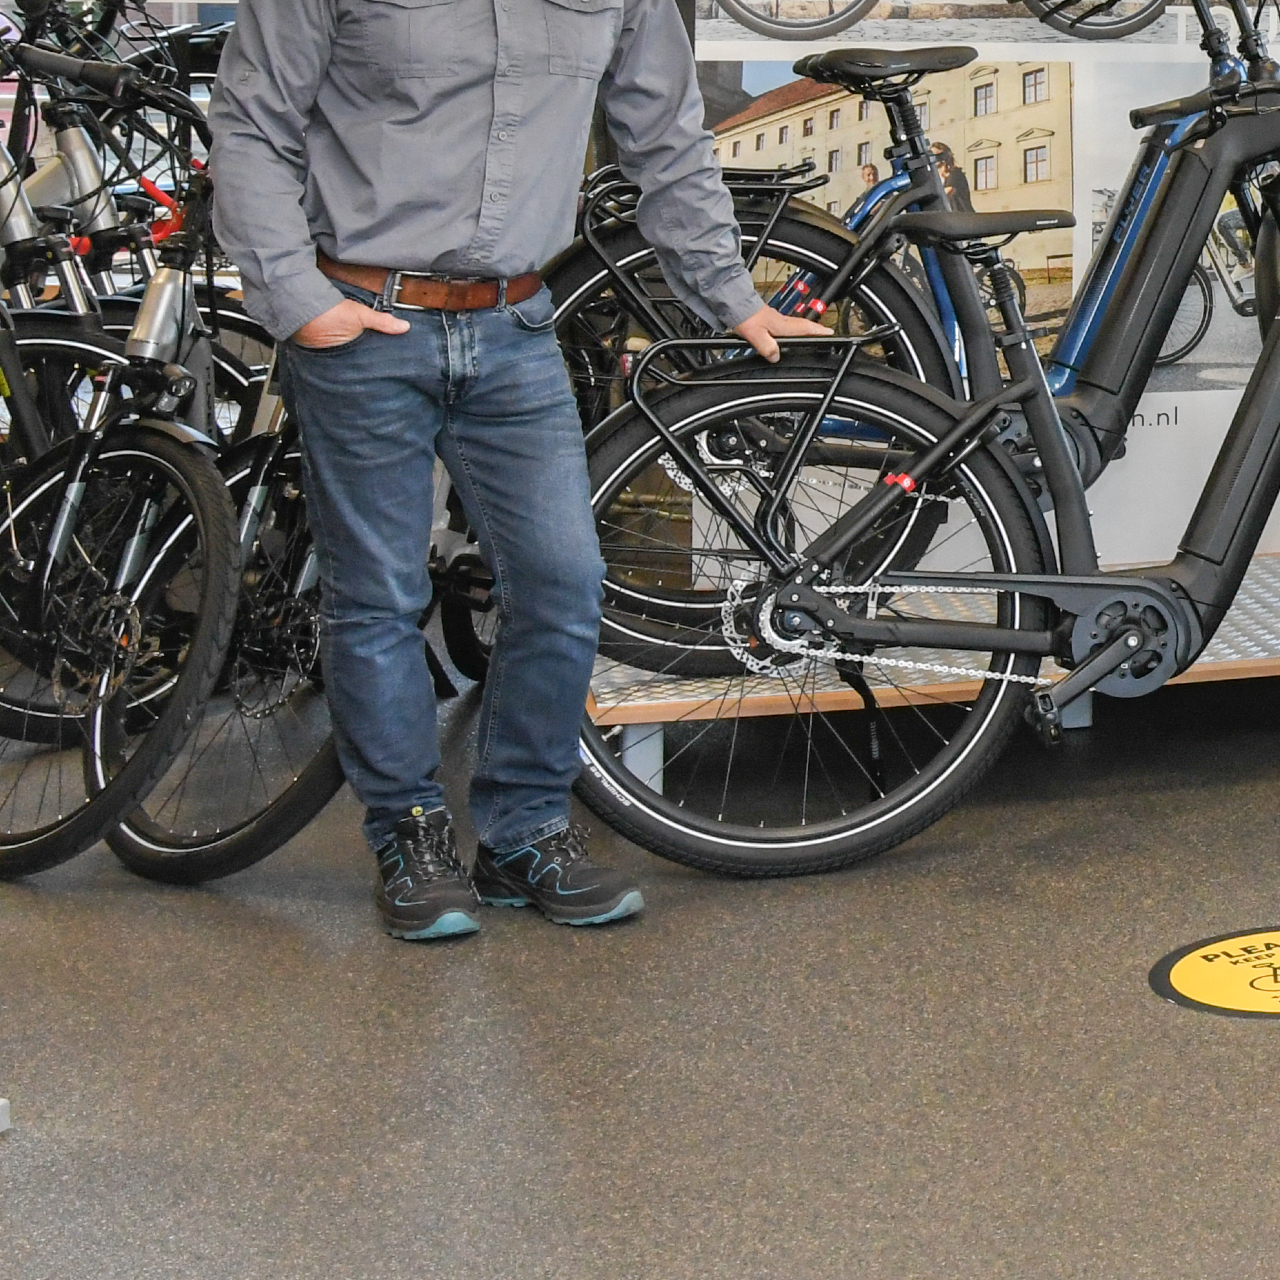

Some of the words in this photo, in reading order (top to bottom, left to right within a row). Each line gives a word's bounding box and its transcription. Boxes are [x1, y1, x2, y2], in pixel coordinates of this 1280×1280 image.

[1113, 165, 1150, 242] FLYER
[1132, 406, 1178, 426] n.nl
[1228, 953, 1276, 966] KEEP
